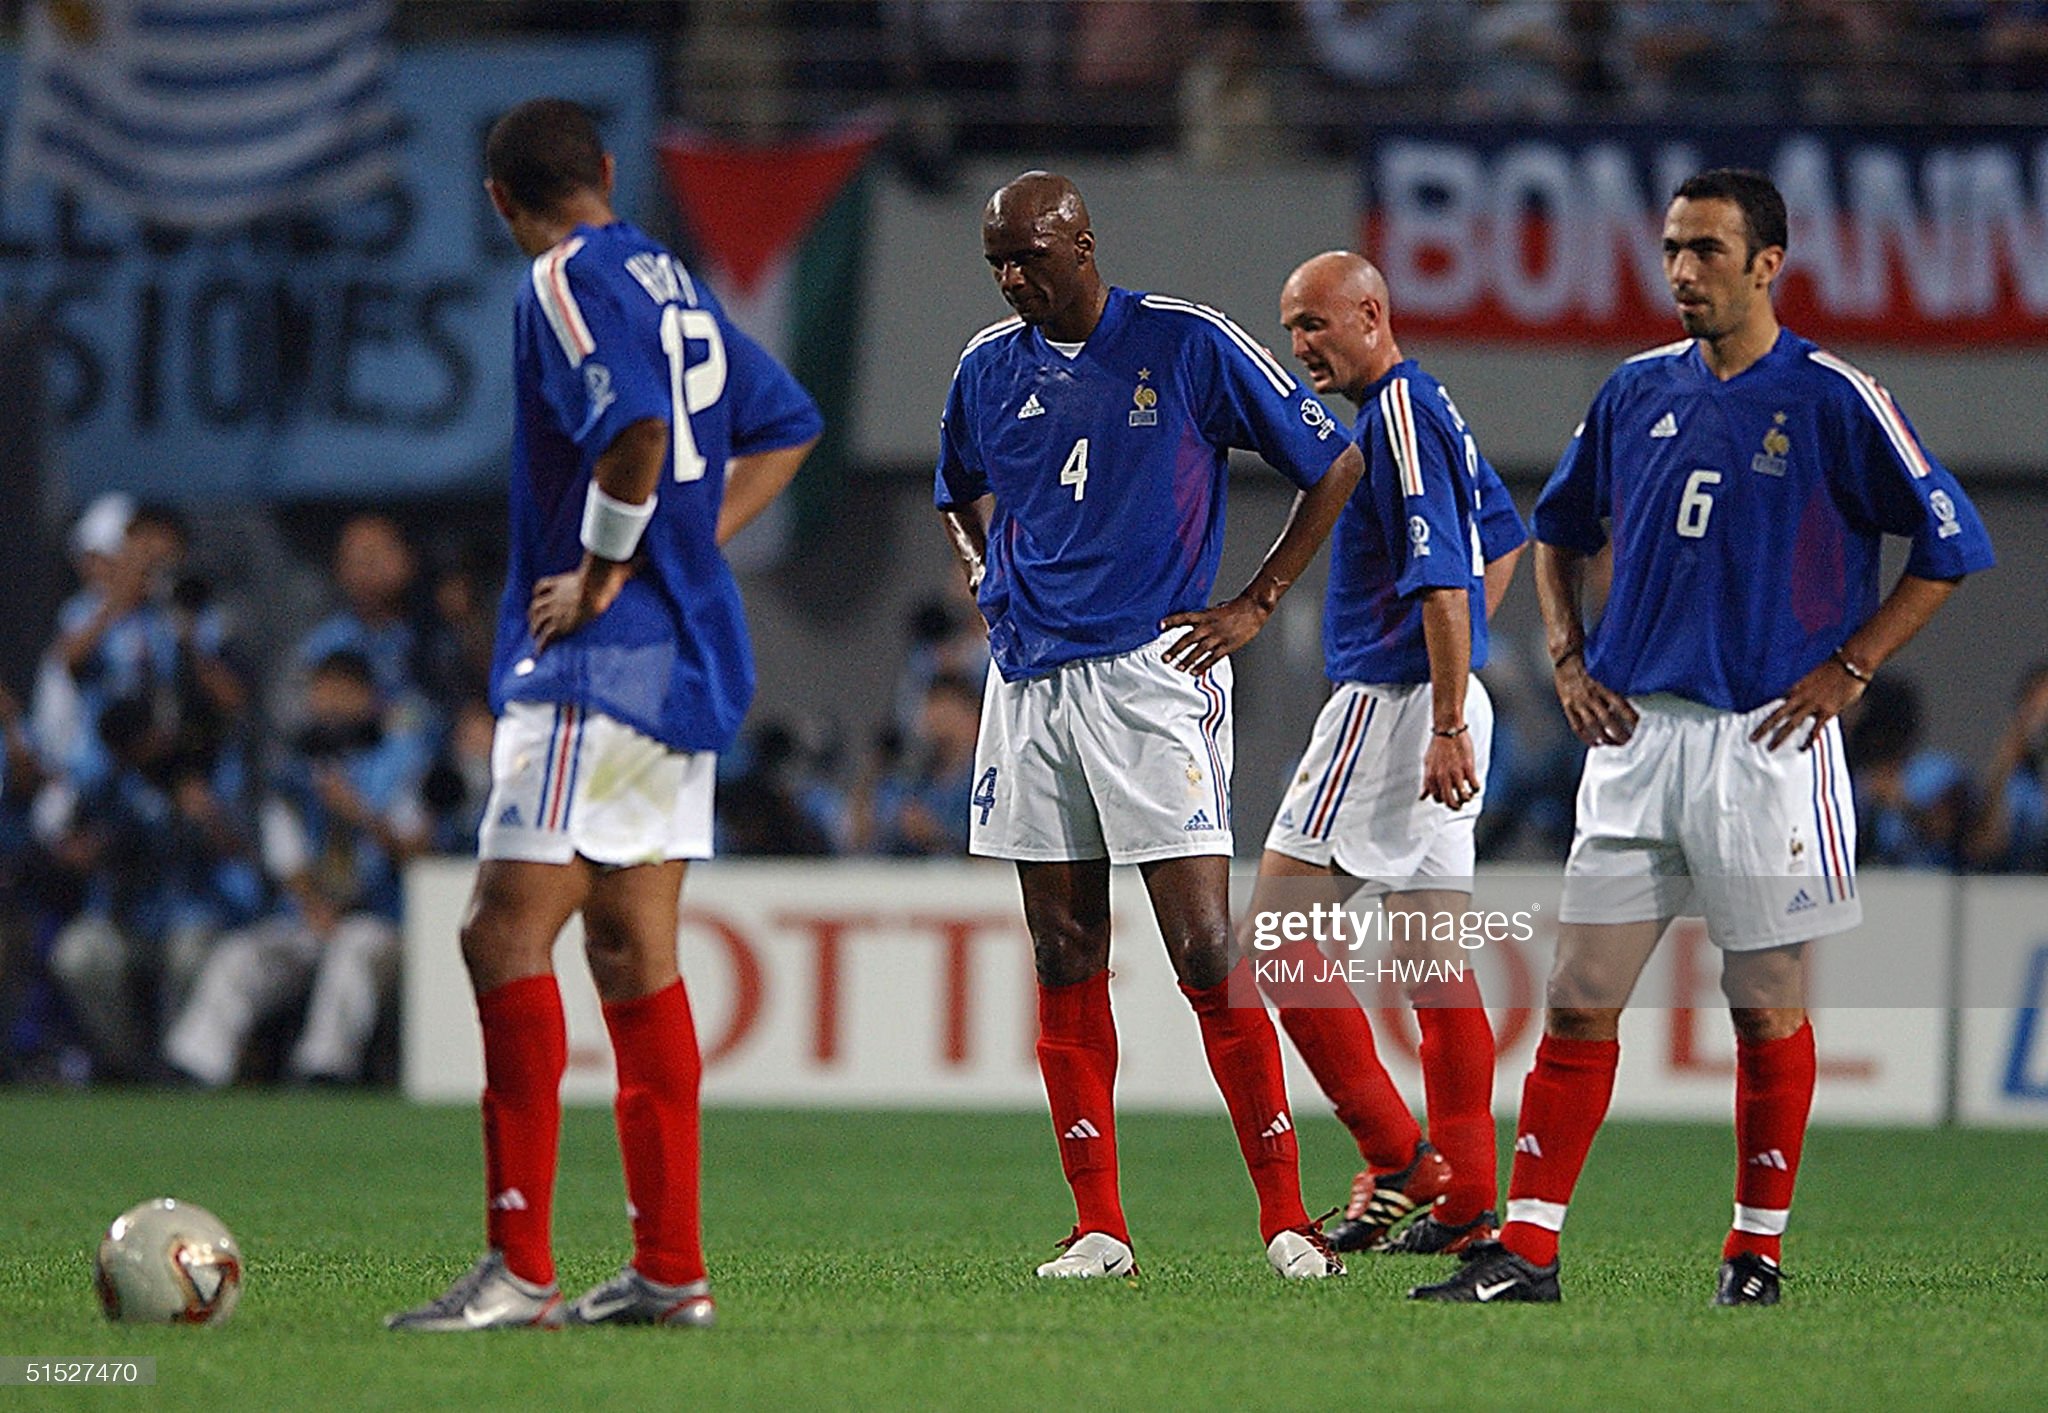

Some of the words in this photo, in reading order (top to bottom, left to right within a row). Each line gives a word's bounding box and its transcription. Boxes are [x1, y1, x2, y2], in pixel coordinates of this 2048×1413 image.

[1060, 438, 1088, 501] 4
[1676, 469, 1722, 538] 6
[973, 767, 997, 826] 4
